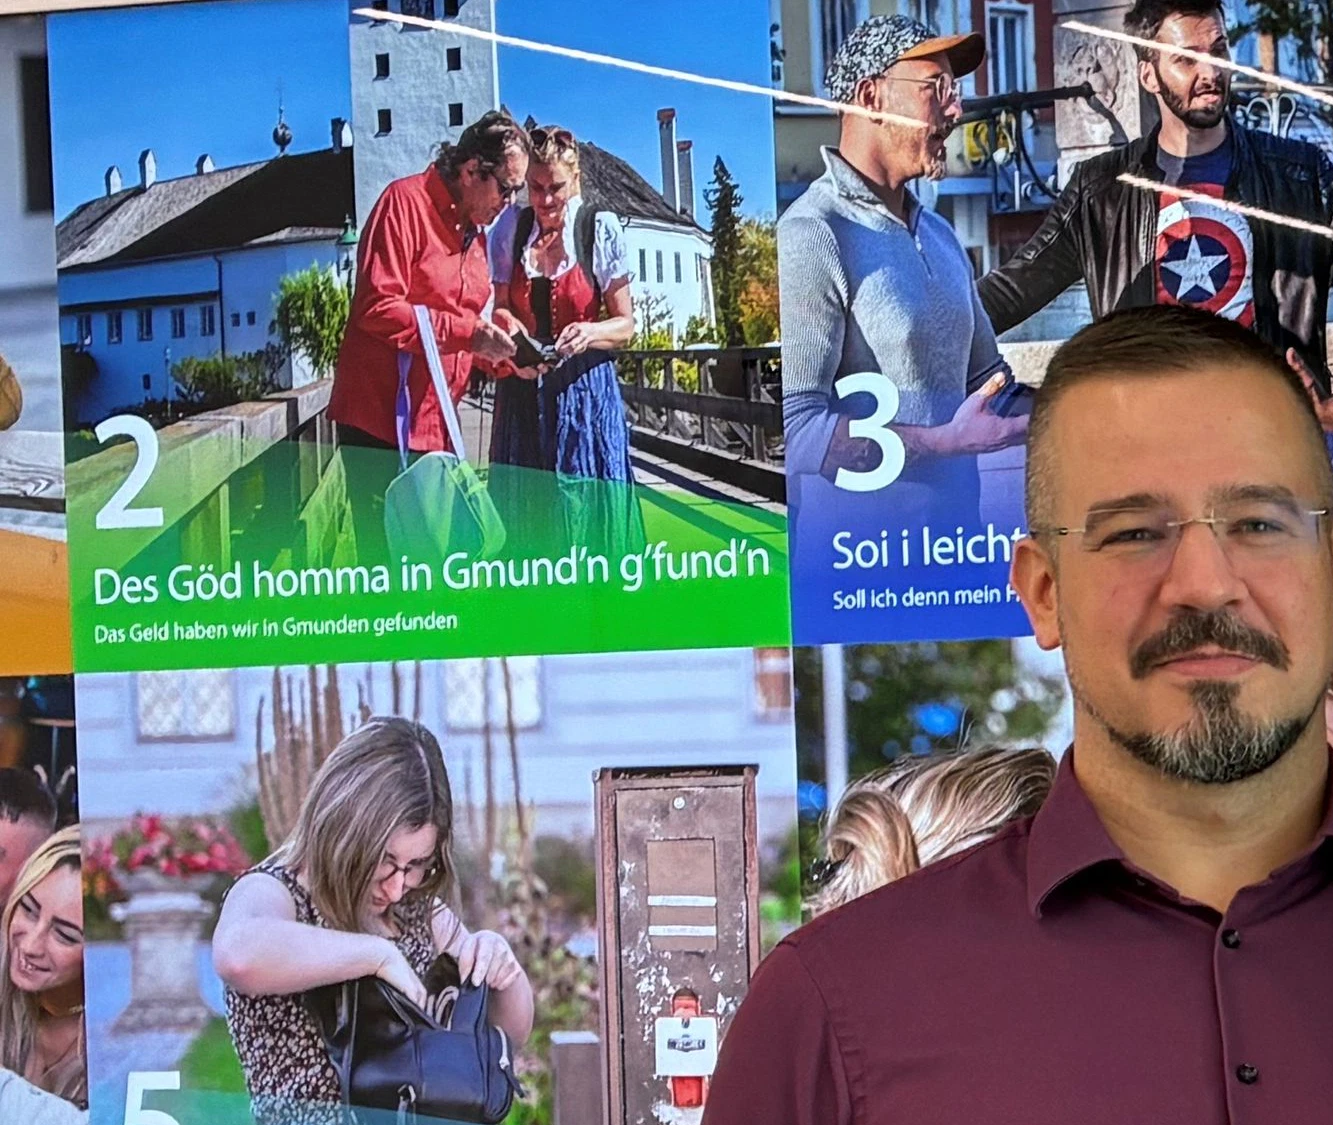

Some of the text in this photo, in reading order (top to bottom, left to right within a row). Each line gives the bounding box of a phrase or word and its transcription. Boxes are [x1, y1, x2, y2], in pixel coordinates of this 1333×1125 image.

[833, 373, 907, 493] 3
[94, 415, 164, 529] 2
[94, 538, 769, 605] Des Göd homma in Gmund'n g'fund'n
[832, 529, 888, 569] Soi
[901, 529, 909, 567] i
[833, 588, 866, 610] Soll
[871, 587, 897, 609] ich
[901, 586, 949, 607] denn
[954, 585, 1001, 605] mein
[95, 610, 458, 644] Das Geld haben wir in Gmunden gefunden
